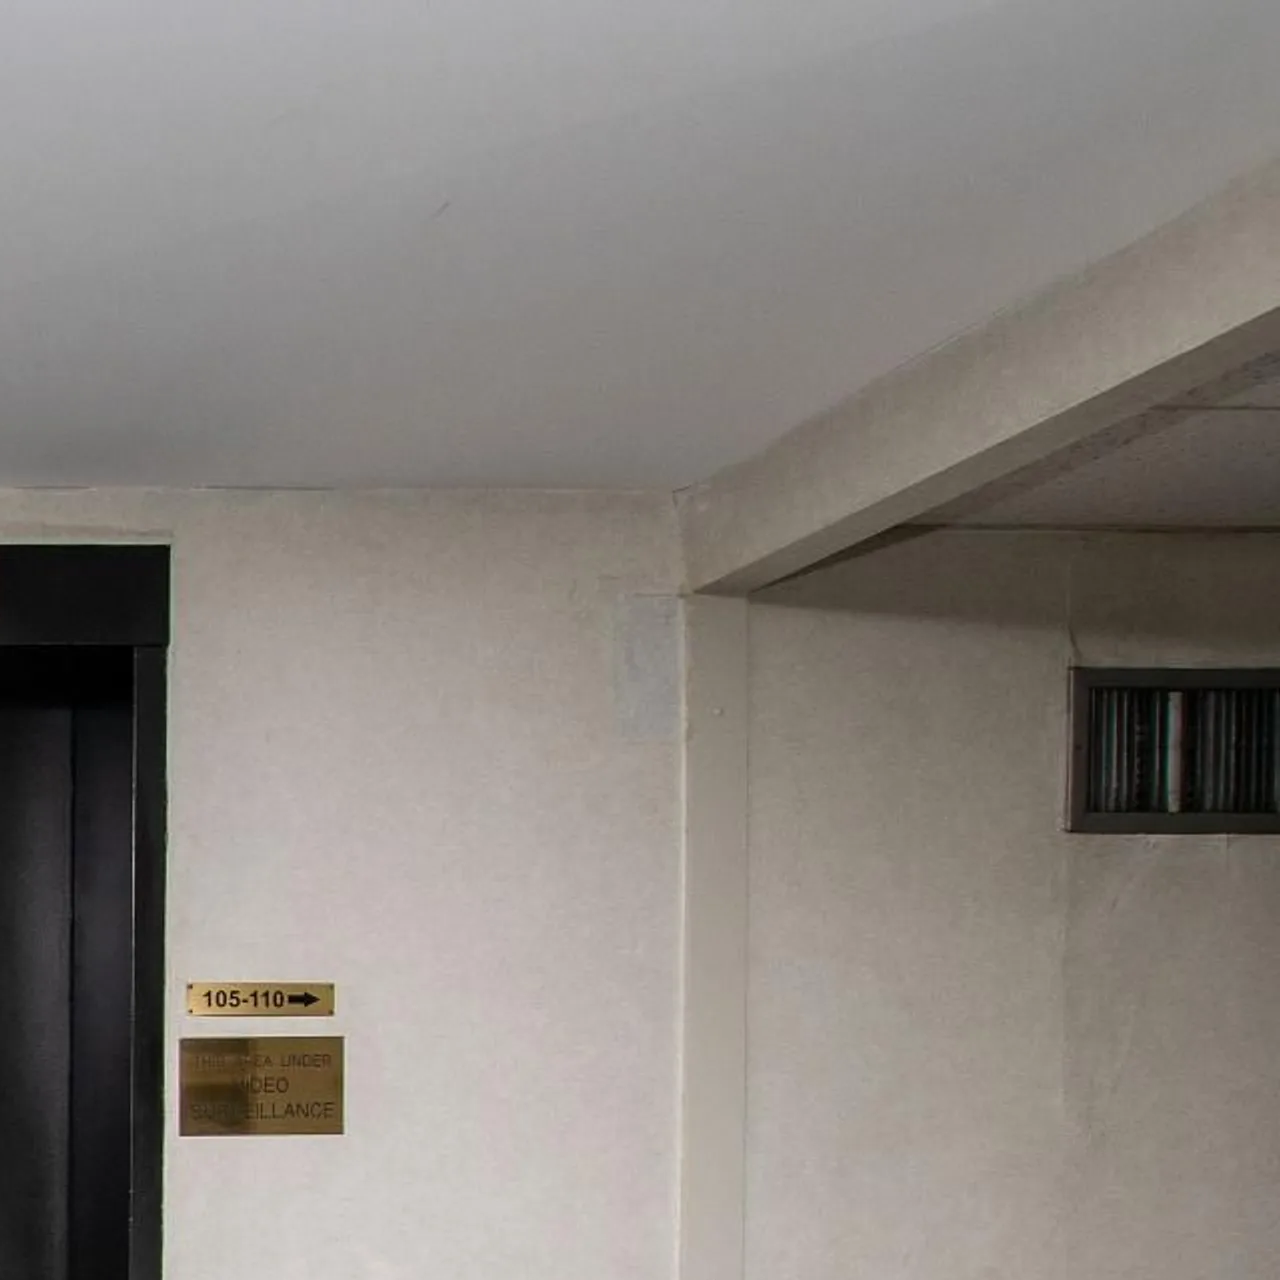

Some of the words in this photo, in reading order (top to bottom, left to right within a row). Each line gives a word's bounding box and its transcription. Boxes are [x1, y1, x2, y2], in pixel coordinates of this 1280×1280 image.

[202, 989, 285, 1008] 105-110
[279, 1053, 332, 1068] UNDER
[191, 1101, 335, 1120] SUREILLANCE
